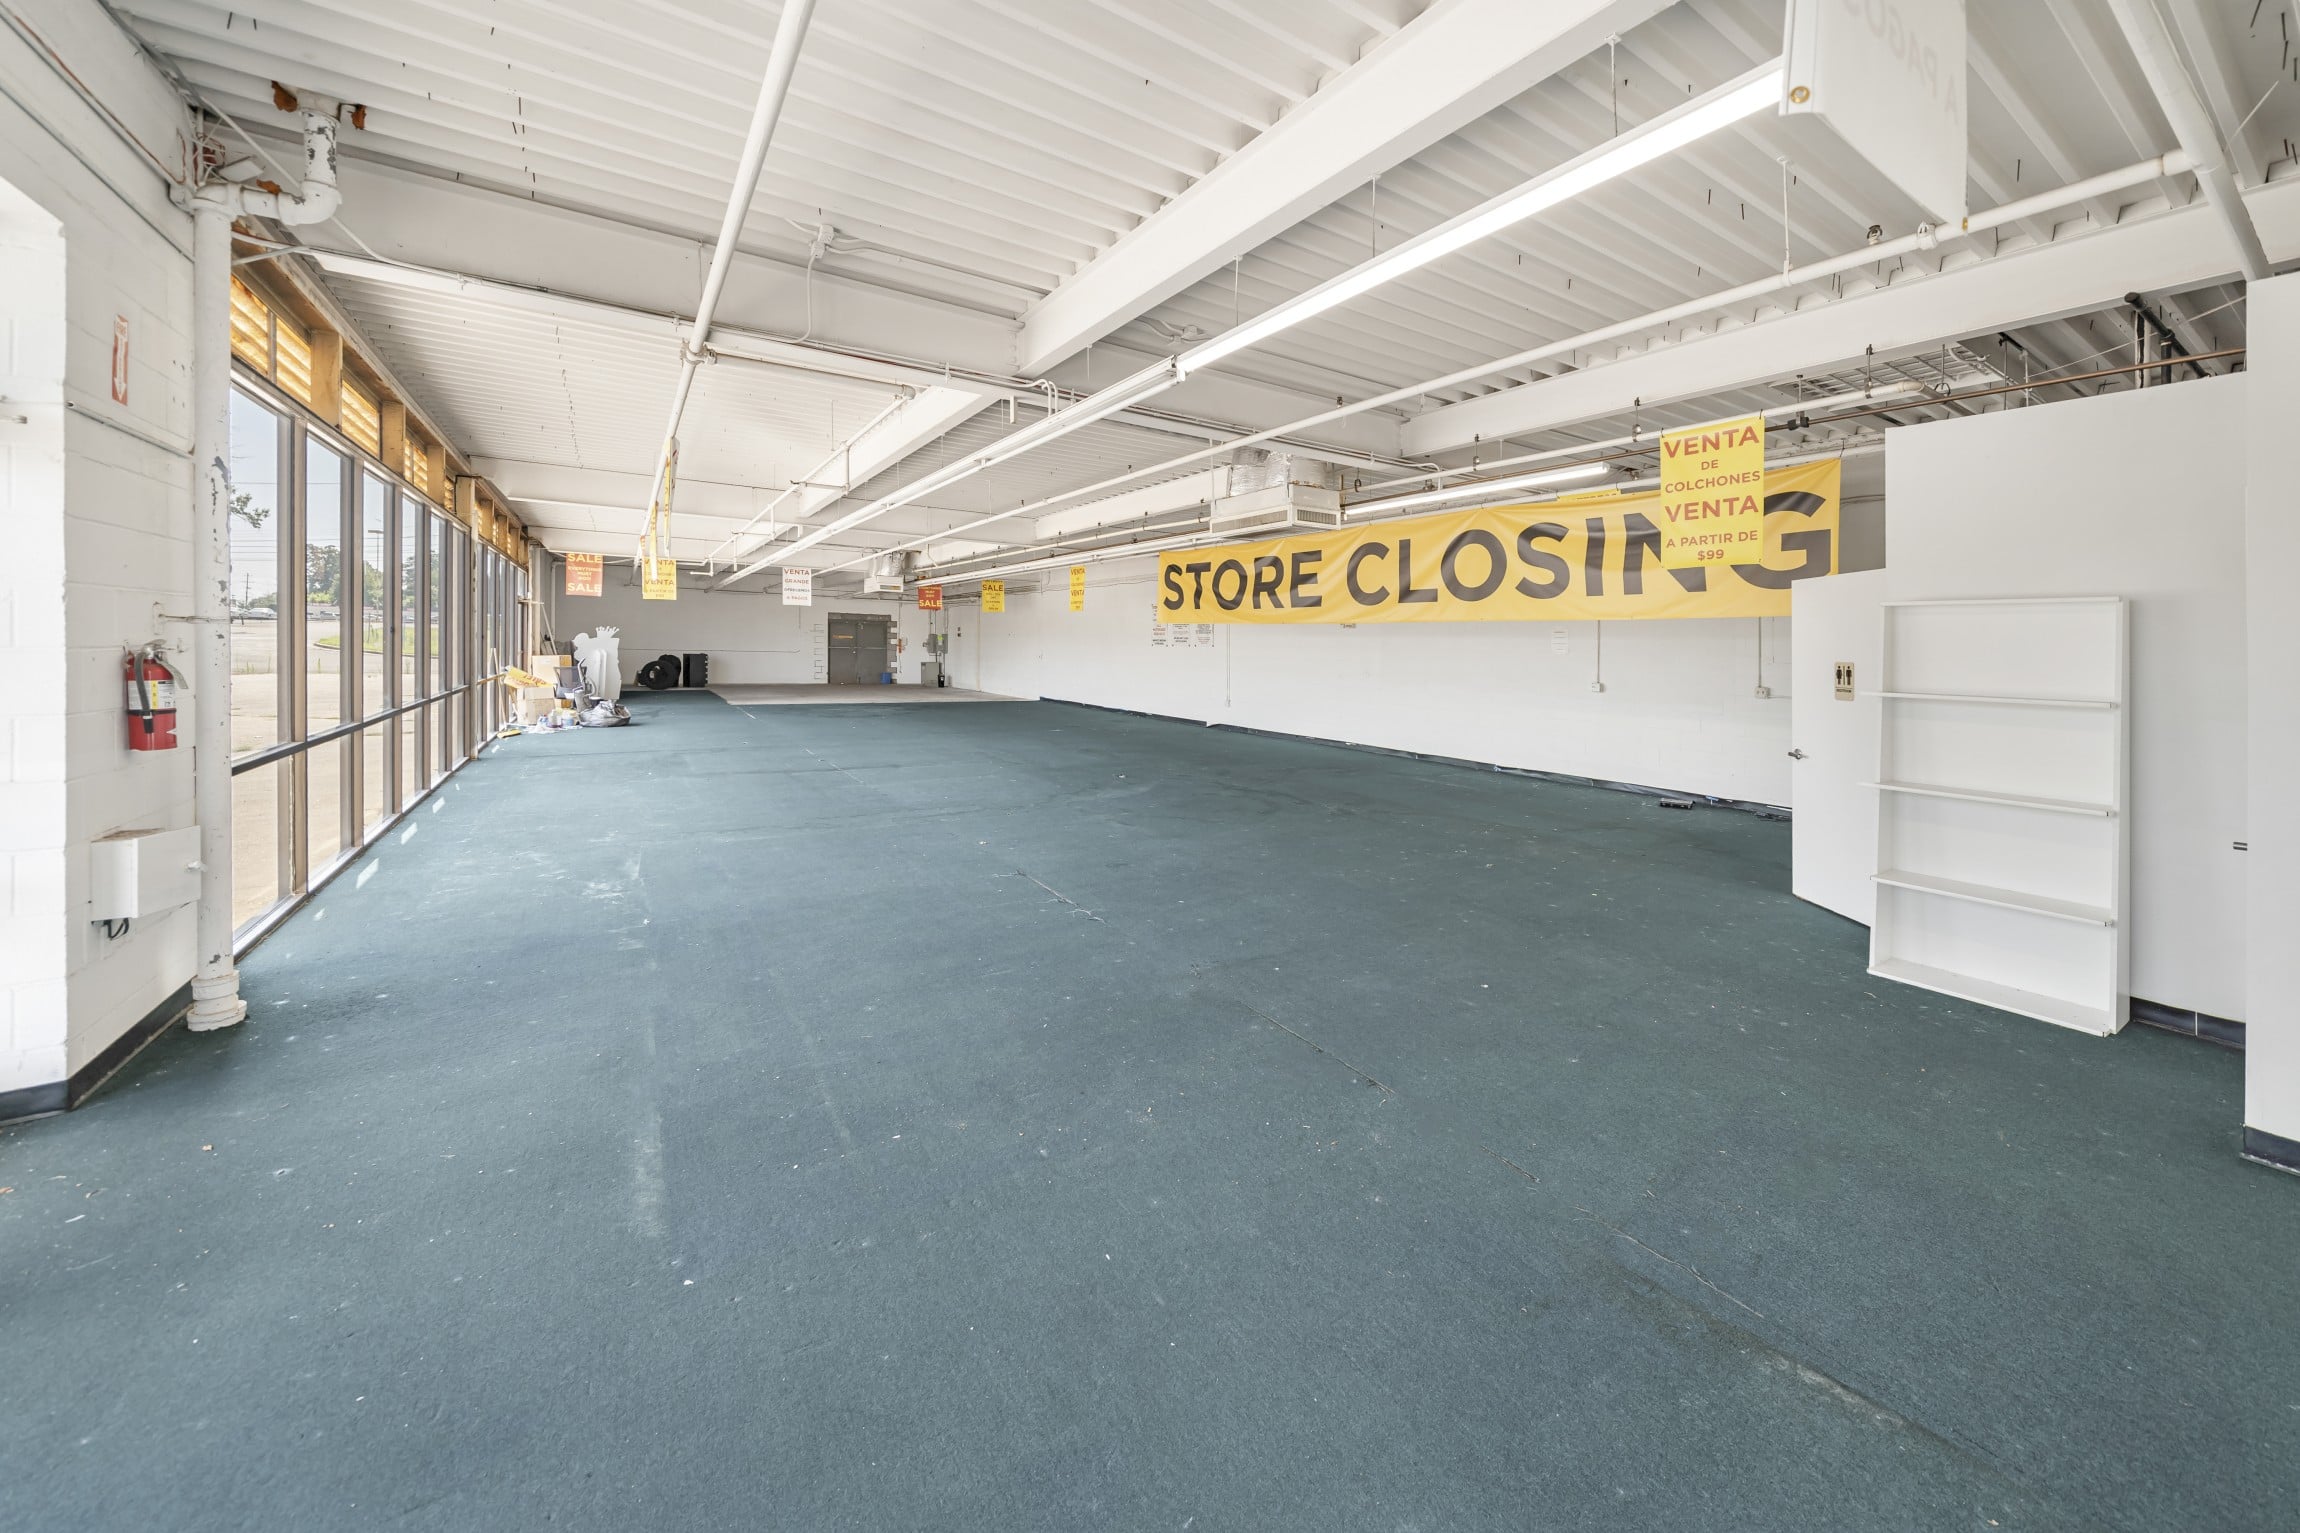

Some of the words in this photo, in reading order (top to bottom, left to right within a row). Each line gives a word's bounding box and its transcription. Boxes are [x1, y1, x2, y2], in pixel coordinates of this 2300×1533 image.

[1664, 425, 1760, 458] VENTA
[1701, 459, 1719, 470] DE
[1665, 470, 1761, 493] COLCHONES
[1664, 495, 1759, 523] VENTA
[1666, 538, 1676, 548] A
[1680, 533, 1733, 546] PARTIR
[1738, 530, 1758, 542] DE
[567, 553, 602, 563] SALE
[1697, 549, 1725, 561] $99
[644, 558, 675, 566] VNTA
[784, 568, 810, 576] VENTA
[1070, 568, 1085, 576] VENTA
[1163, 550, 1323, 611] STORE
[567, 582, 602, 593] SALE
[919, 599, 943, 607] SALE
